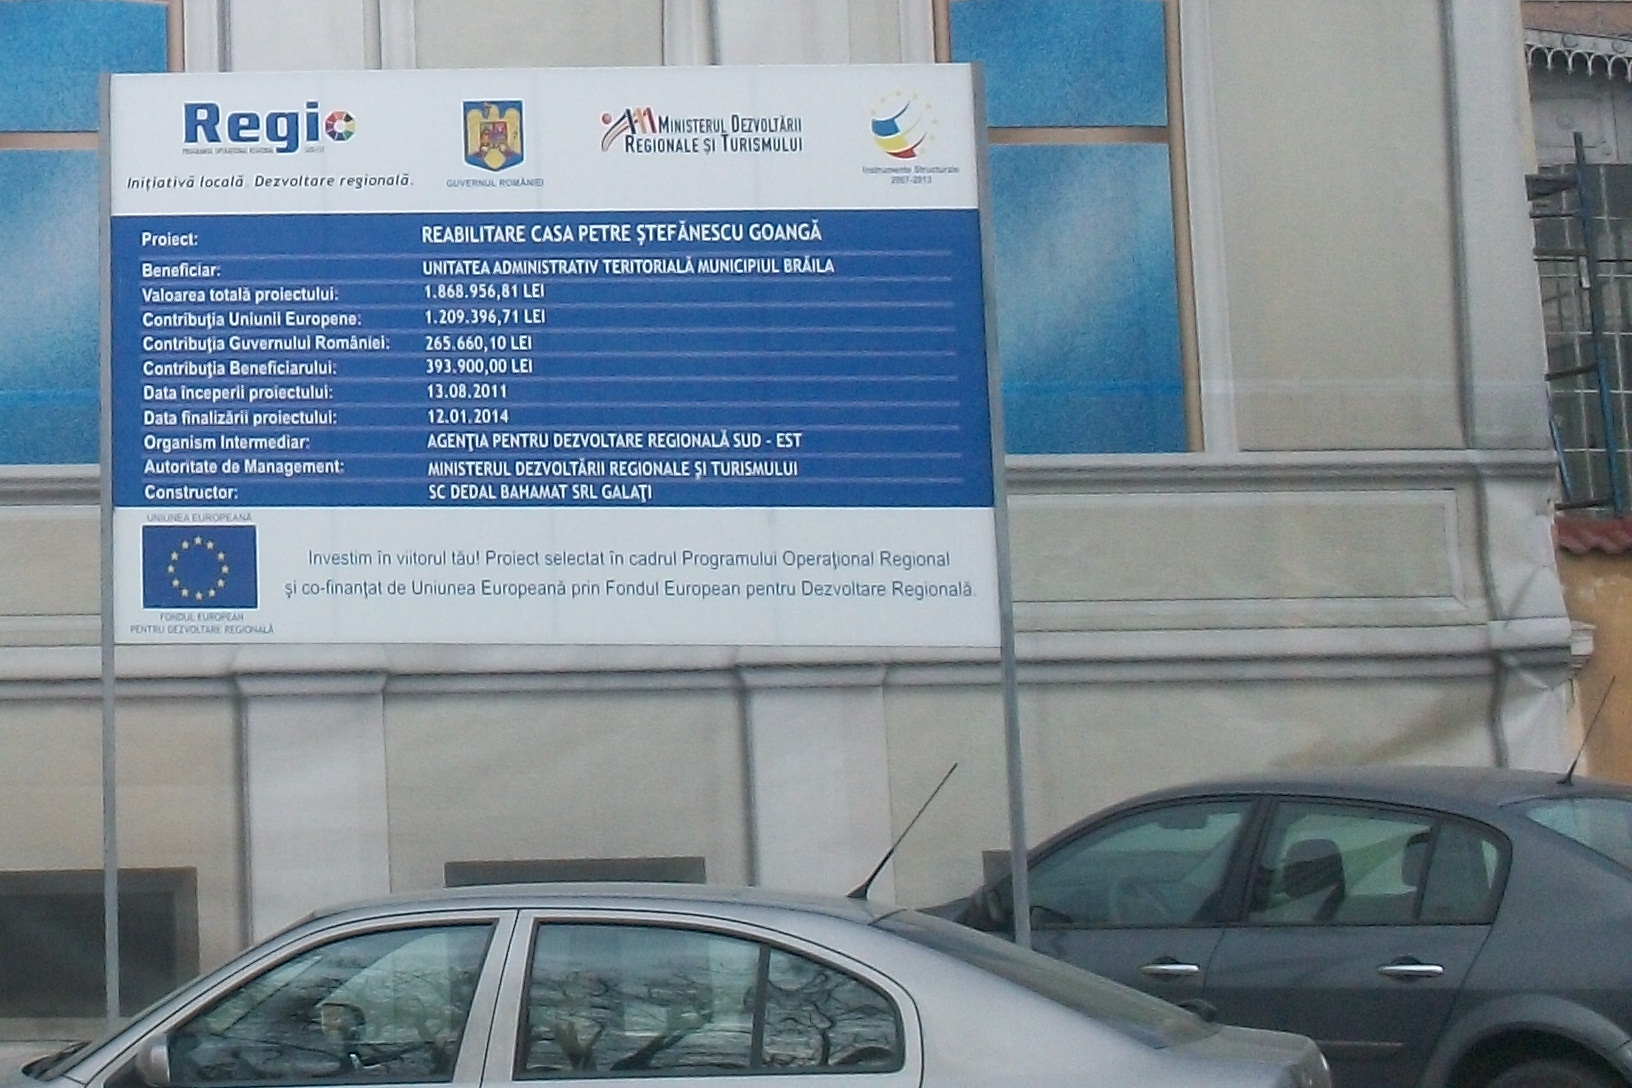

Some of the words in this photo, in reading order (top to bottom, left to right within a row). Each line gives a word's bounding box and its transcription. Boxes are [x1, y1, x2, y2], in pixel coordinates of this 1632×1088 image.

[183, 100, 357, 154] Regio
[254, 174, 335, 188] Dezvoltare
[339, 173, 414, 190] regională.
[446, 178, 496, 188] GUVERNUL
[141, 232, 199, 247] Proiect:
[421, 224, 527, 243] REABILITARE
[530, 224, 575, 243] CASA
[578, 223, 632, 242] PETRE
[749, 218, 822, 242] GOANGĂ
[141, 262, 222, 278] Beneficiar:
[422, 259, 491, 276] UNITATEA
[492, 258, 599, 275] ADMINISTRATIV
[602, 255, 695, 275] TERITORIALĂ
[697, 258, 780, 274] MUNICIPIUL
[783, 255, 836, 275] BRĂILA
[142, 287, 206, 303] Valoarea
[209, 286, 252, 302] totală
[254, 286, 339, 305] proiectului:
[424, 283, 519, 301] 1.868.956,81
[523, 283, 546, 299] LEI
[228, 312, 282, 327] Uniunii
[285, 312, 362, 329] Europene:
[424, 308, 520, 326] 1.209.396,71
[523, 308, 546, 324] LEI
[228, 335, 312, 351] Guvernului
[315, 335, 391, 351] României:
[425, 335, 508, 353] 265.660,10
[511, 335, 533, 351] LEI
[229, 360, 337, 376] Beneficiarului:
[425, 358, 508, 376] 393.900,00
[511, 358, 534, 374] LEI
[143, 385, 178, 401] Data
[181, 385, 246, 403] începerii
[249, 385, 334, 403] proiectului:
[426, 383, 508, 400] 13.08.2011
[143, 410, 178, 426] Data
[181, 409, 250, 425] finalizării
[253, 409, 338, 428] proiectului:
[427, 408, 510, 425] 12.01.2014
[143, 435, 217, 453] Organism
[220, 434, 311, 450] Intermediar:
[492, 432, 550, 449] PENTRU
[553, 432, 644, 449] DEZVOLTARE
[647, 428, 731, 449] REGIONALĂ
[733, 432, 762, 449] SUD
[776, 432, 803, 449] EST
[143, 460, 218, 475] Autoritate
[221, 460, 241, 475] de
[244, 459, 346, 477] Management:
[427, 461, 512, 477] MINISTERUL
[515, 456, 606, 477] DEZVOLTĂRII
[609, 461, 691, 477] REGIONALE
[711, 460, 799, 477] TURISMULUI
[144, 484, 239, 500] Constructor:
[428, 484, 447, 500] SC
[449, 484, 496, 500] DEDAL
[499, 484, 568, 500] BAHAMAT
[571, 484, 599, 500] SRL
[146, 513, 191, 523] UNIUNEA
[308, 550, 372, 566] Investim
[377, 550, 392, 566] în
[396, 549, 447, 566] viitorul
[451, 549, 480, 566] tău!
[484, 549, 540, 566] Proiect
[543, 550, 605, 567] selectat
[609, 550, 625, 567] în
[629, 550, 678, 567] cadrul
[682, 550, 778, 570] Programului
[879, 551, 950, 570] Regional
[387, 579, 407, 595] de
[411, 580, 476, 596] Uniunea
[481, 580, 566, 599] Europeană
[571, 581, 600, 599] prin
[605, 580, 659, 597] Fondul
[664, 580, 741, 599] European
[745, 581, 797, 599] pentru
[801, 581, 886, 597] Dezvoltare
[159, 612, 195, 621] FONDUL
[197, 612, 245, 621] EUROPEAN
[129, 624, 165, 634] PENTRU
[167, 624, 221, 634] DEZVOLTARE
